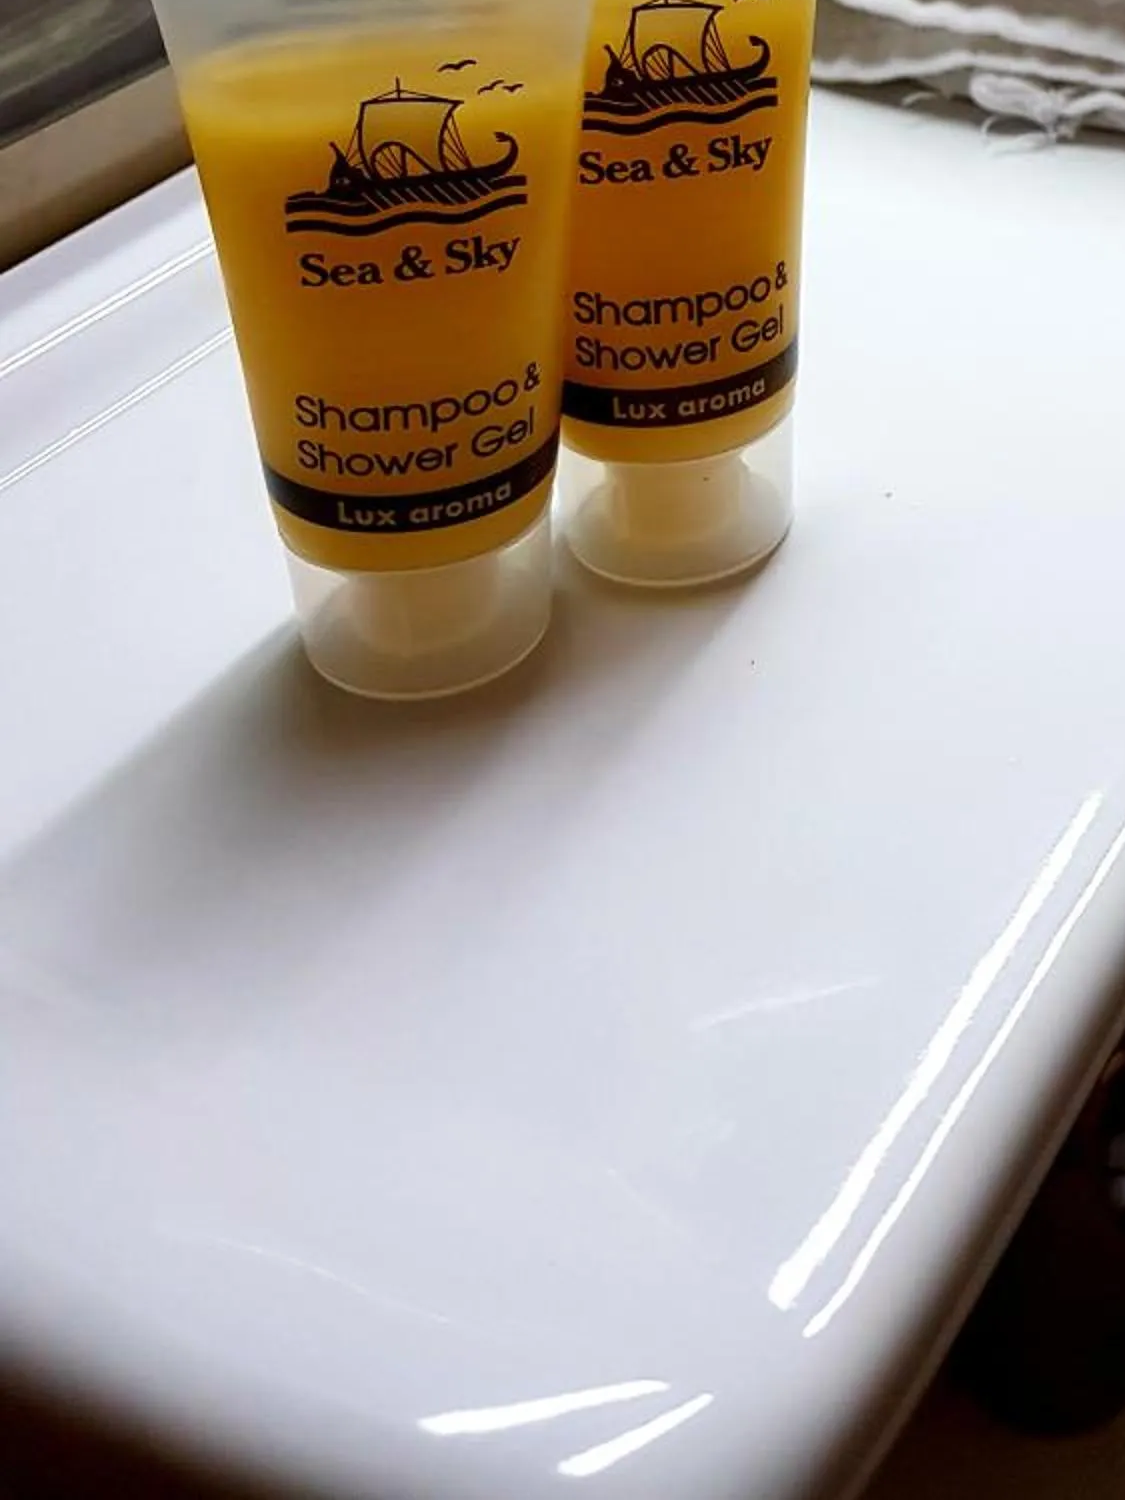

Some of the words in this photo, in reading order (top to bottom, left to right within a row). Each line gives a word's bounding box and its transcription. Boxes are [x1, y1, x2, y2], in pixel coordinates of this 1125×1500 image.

[578, 151, 654, 184] Sea
[662, 143, 700, 179] &
[707, 135, 772, 172] Sky
[299, 252, 384, 287] Sea
[394, 245, 435, 281] &
[444, 236, 521, 274] Sky
[573, 276, 771, 326] Shampoo
[775, 260, 788, 290] &
[575, 335, 721, 371] Shower
[730, 304, 784, 352] Gel
[295, 379, 519, 433] Shampoo
[523, 361, 541, 391] &
[612, 396, 666, 420] Lux
[677, 377, 766, 417] aroma
[297, 440, 459, 477] Shower
[471, 406, 535, 457] Gel
[337, 501, 397, 526] Lux
[408, 481, 512, 524] aroma
